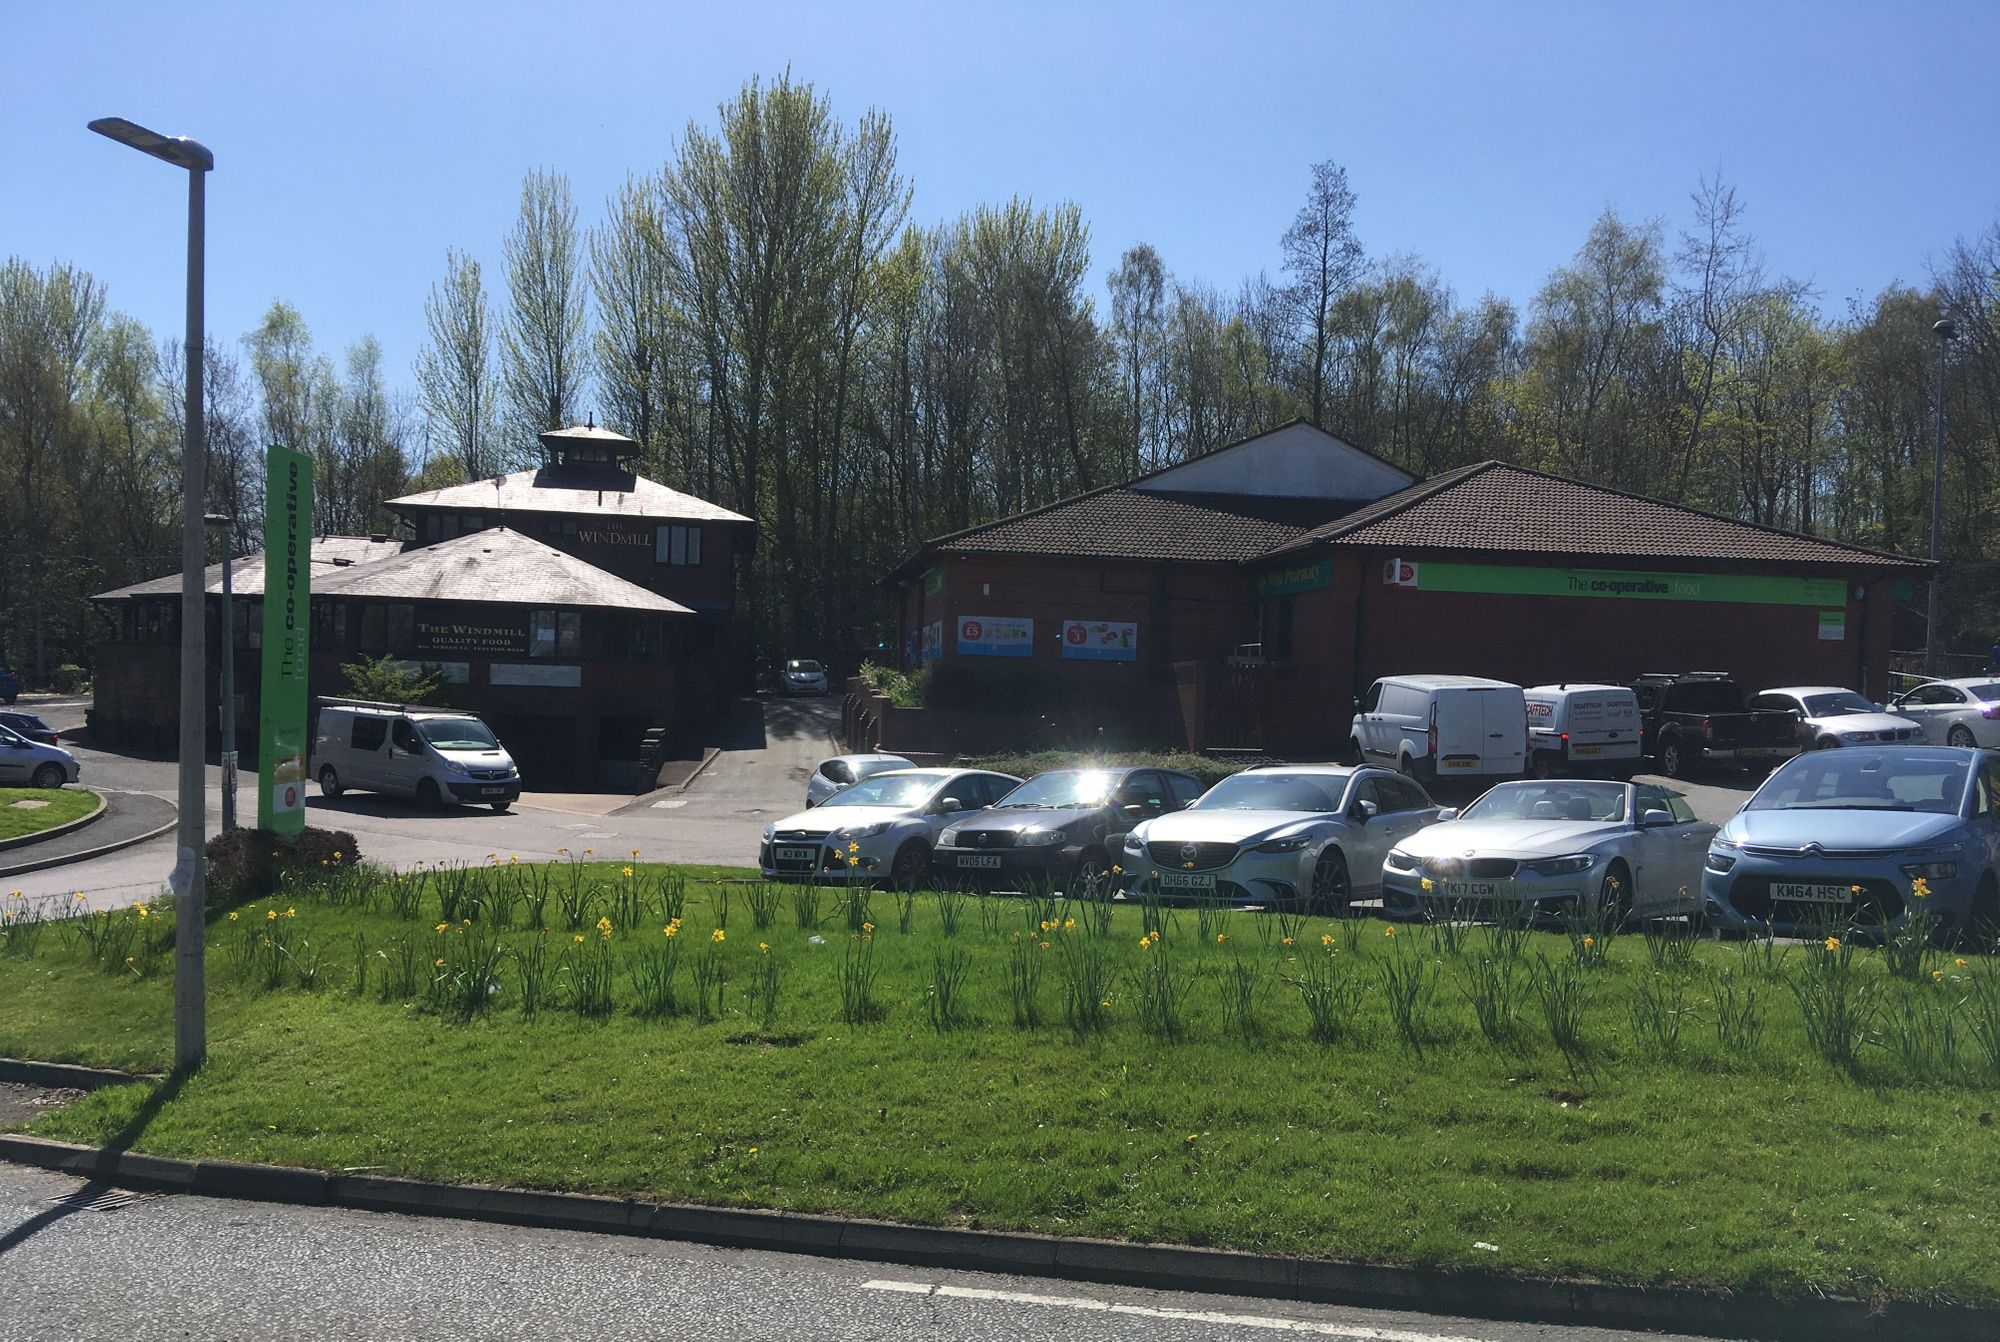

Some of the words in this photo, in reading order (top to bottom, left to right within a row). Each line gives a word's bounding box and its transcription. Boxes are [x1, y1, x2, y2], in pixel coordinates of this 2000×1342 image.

[285, 461, 299, 631] co-operative
[579, 530, 652, 546] WINDMILL
[1567, 576, 1588, 591] The
[1591, 580, 1669, 595] co-operative
[1674, 580, 1701, 595] food
[966, 626, 979, 637] £5
[432, 636, 479, 646] QUALITY
[482, 639, 512, 647] FOOD
[281, 637, 294, 681] The
[294, 627, 305, 681] food
[1164, 874, 1189, 886] DH66
[1191, 876, 1212, 887] GZJ
[1443, 882, 1468, 894] YK17
[1471, 883, 1495, 895] CGW
[1776, 884, 1814, 898] KM64
[1817, 886, 1846, 900] HSC
